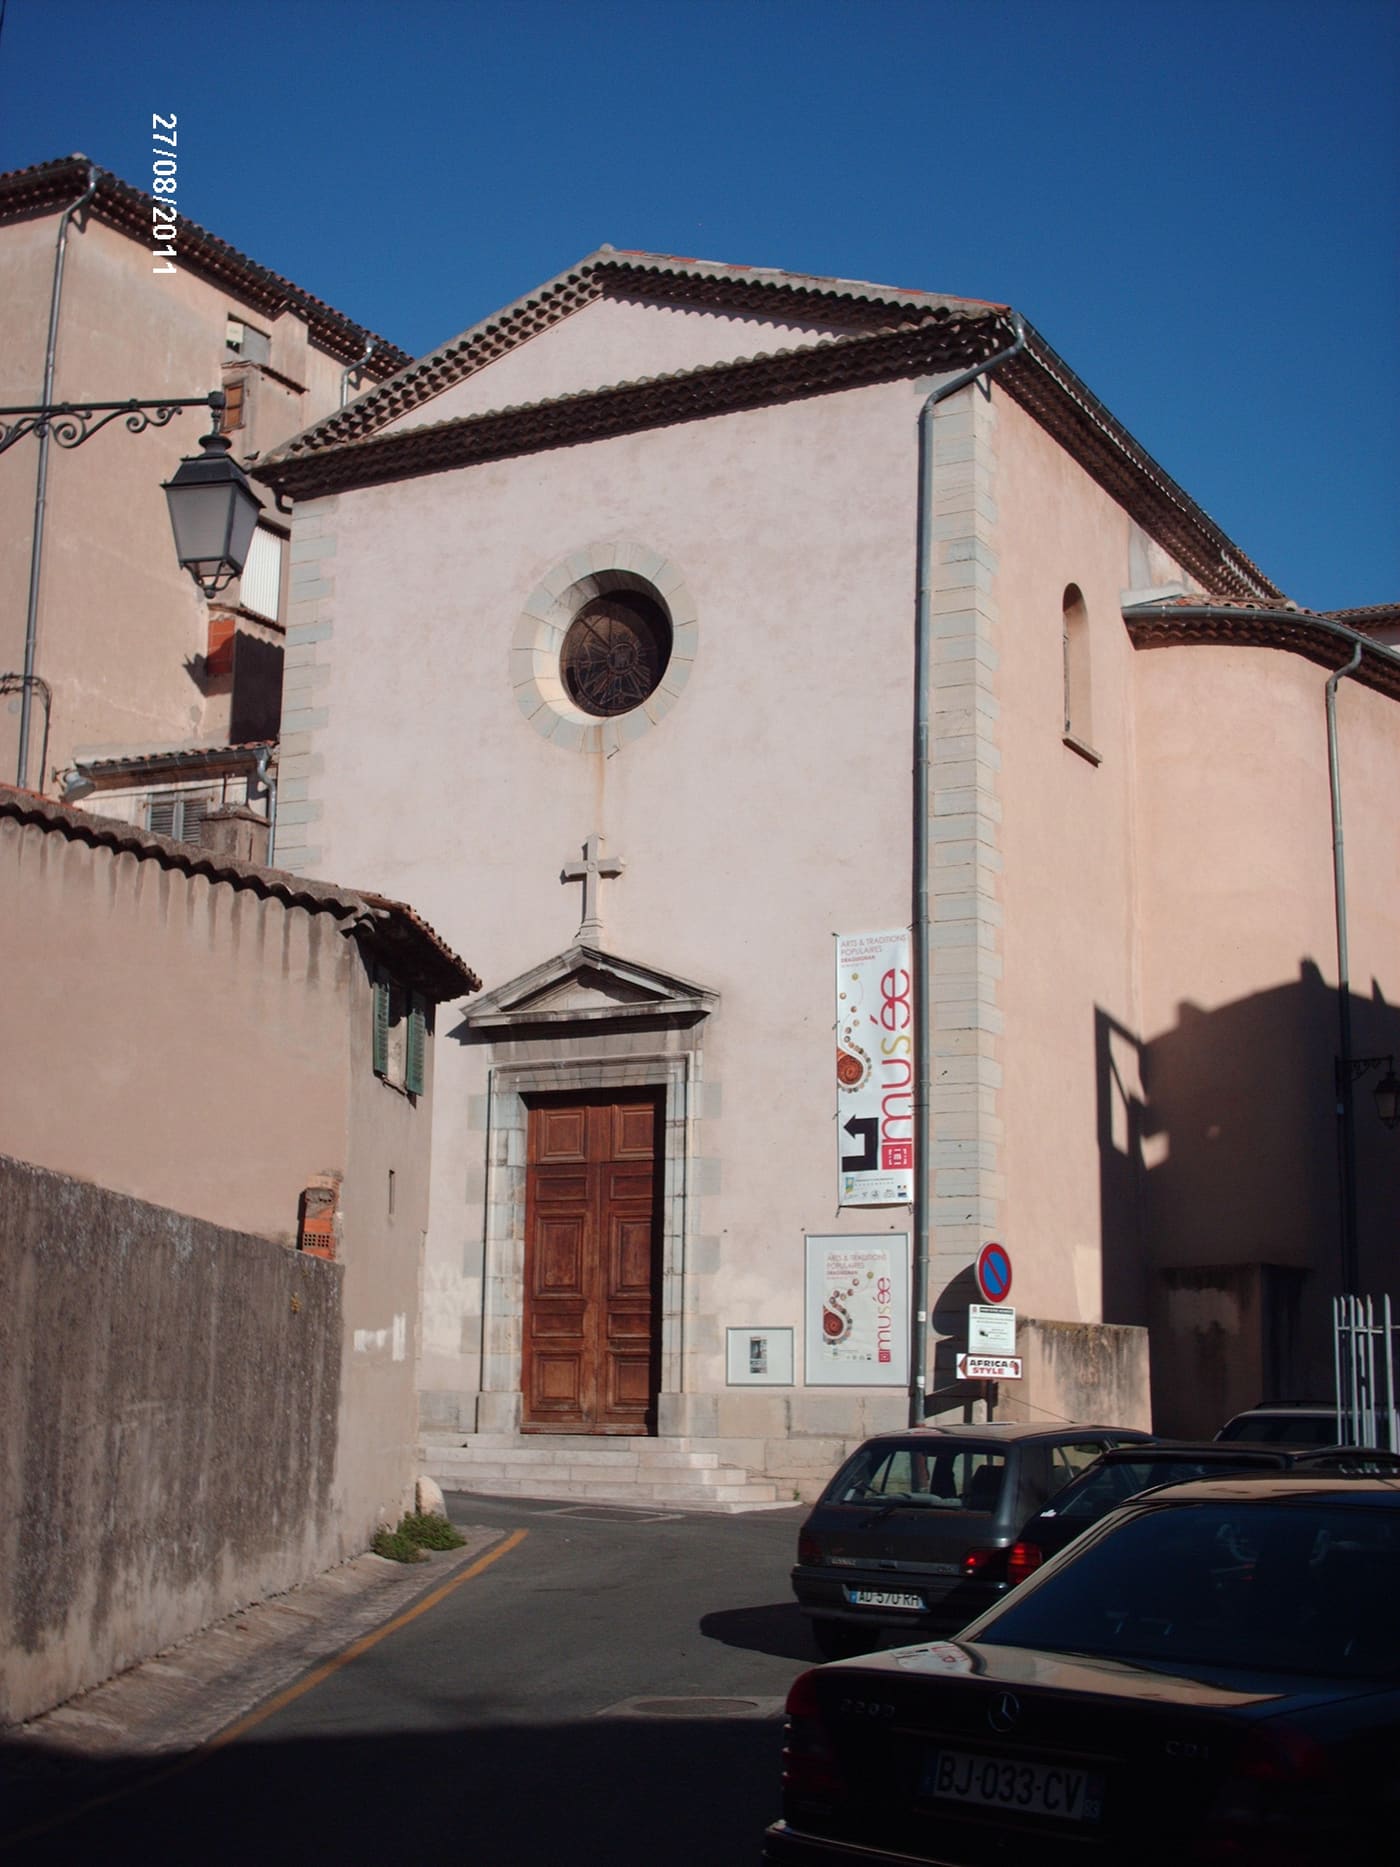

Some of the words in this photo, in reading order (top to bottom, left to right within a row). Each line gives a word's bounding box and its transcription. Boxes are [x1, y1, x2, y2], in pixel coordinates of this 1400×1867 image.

[869, 968, 912, 1142] musée
[872, 1277, 890, 1351] musée
[970, 1359, 1008, 1367] AFRICA
[972, 1367, 1004, 1375] STYLE
